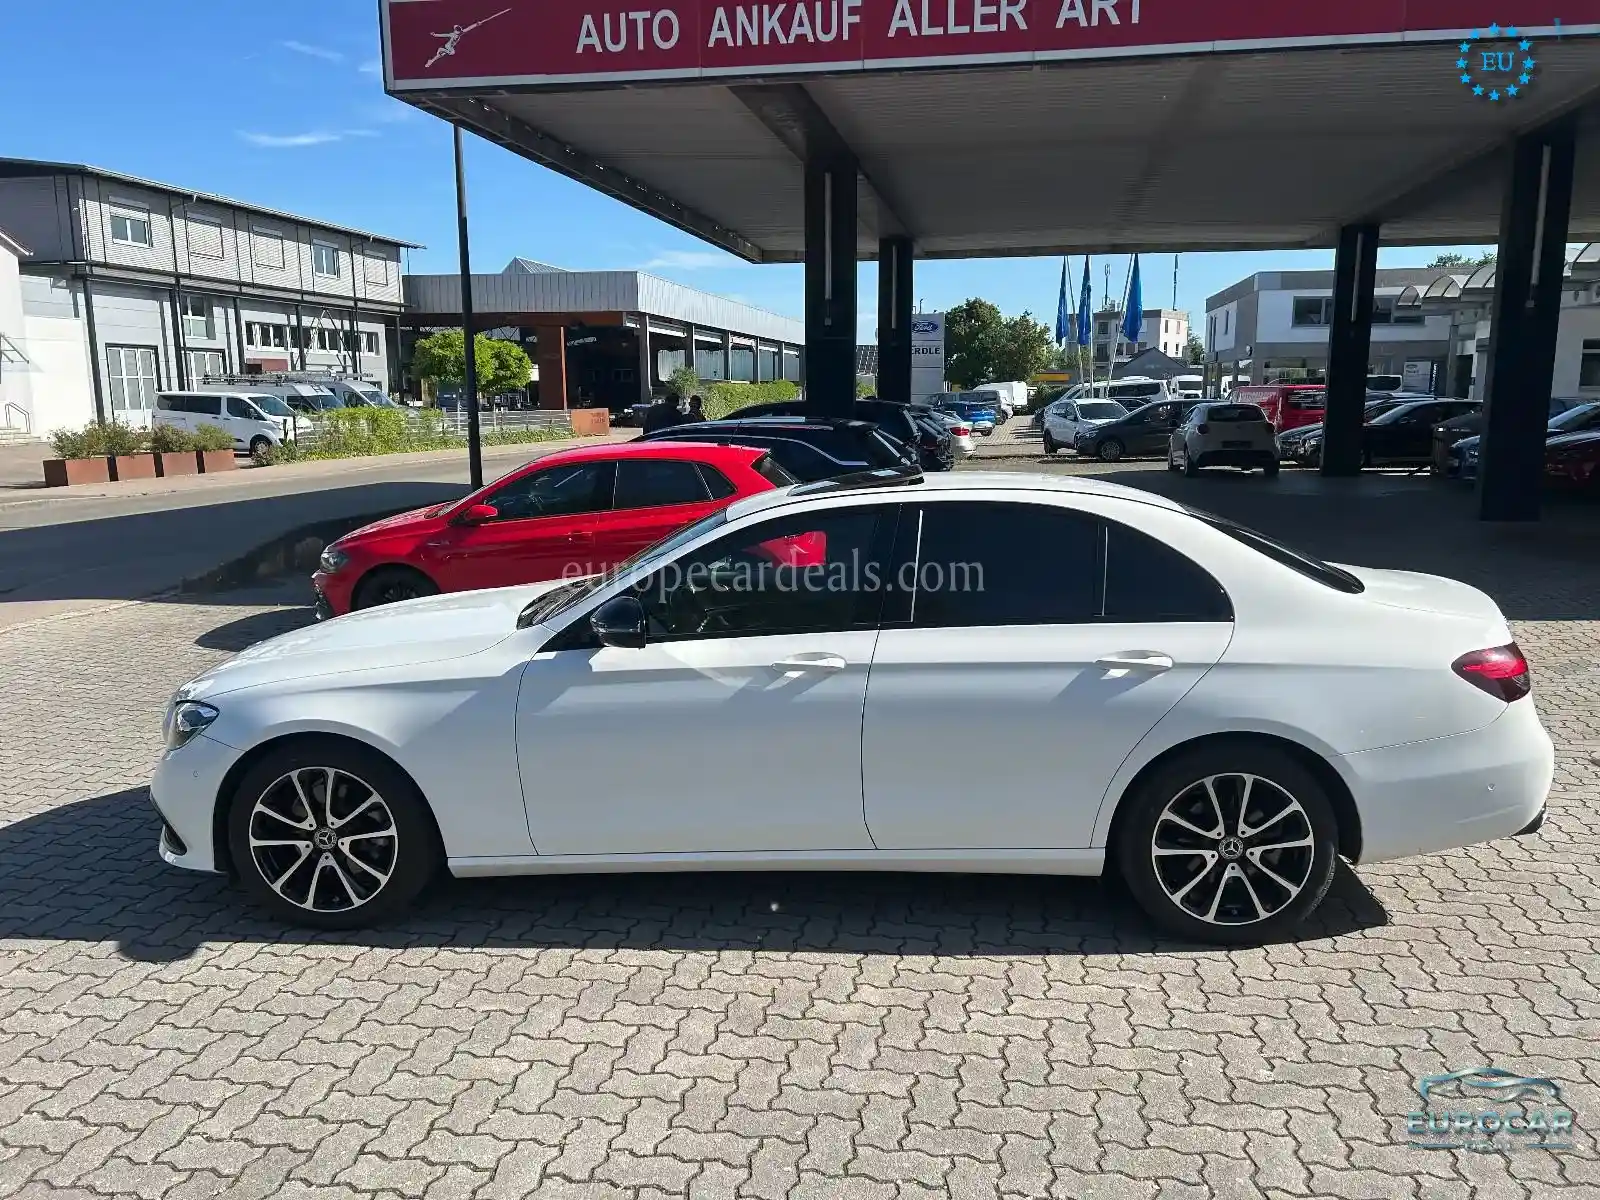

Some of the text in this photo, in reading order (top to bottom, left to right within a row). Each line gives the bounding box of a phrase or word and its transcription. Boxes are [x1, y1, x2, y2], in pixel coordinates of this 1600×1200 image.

[576, 9, 679, 53] AUTO
[708, 0, 862, 47] ANKAUF
[888, 0, 1028, 37] ALLER
